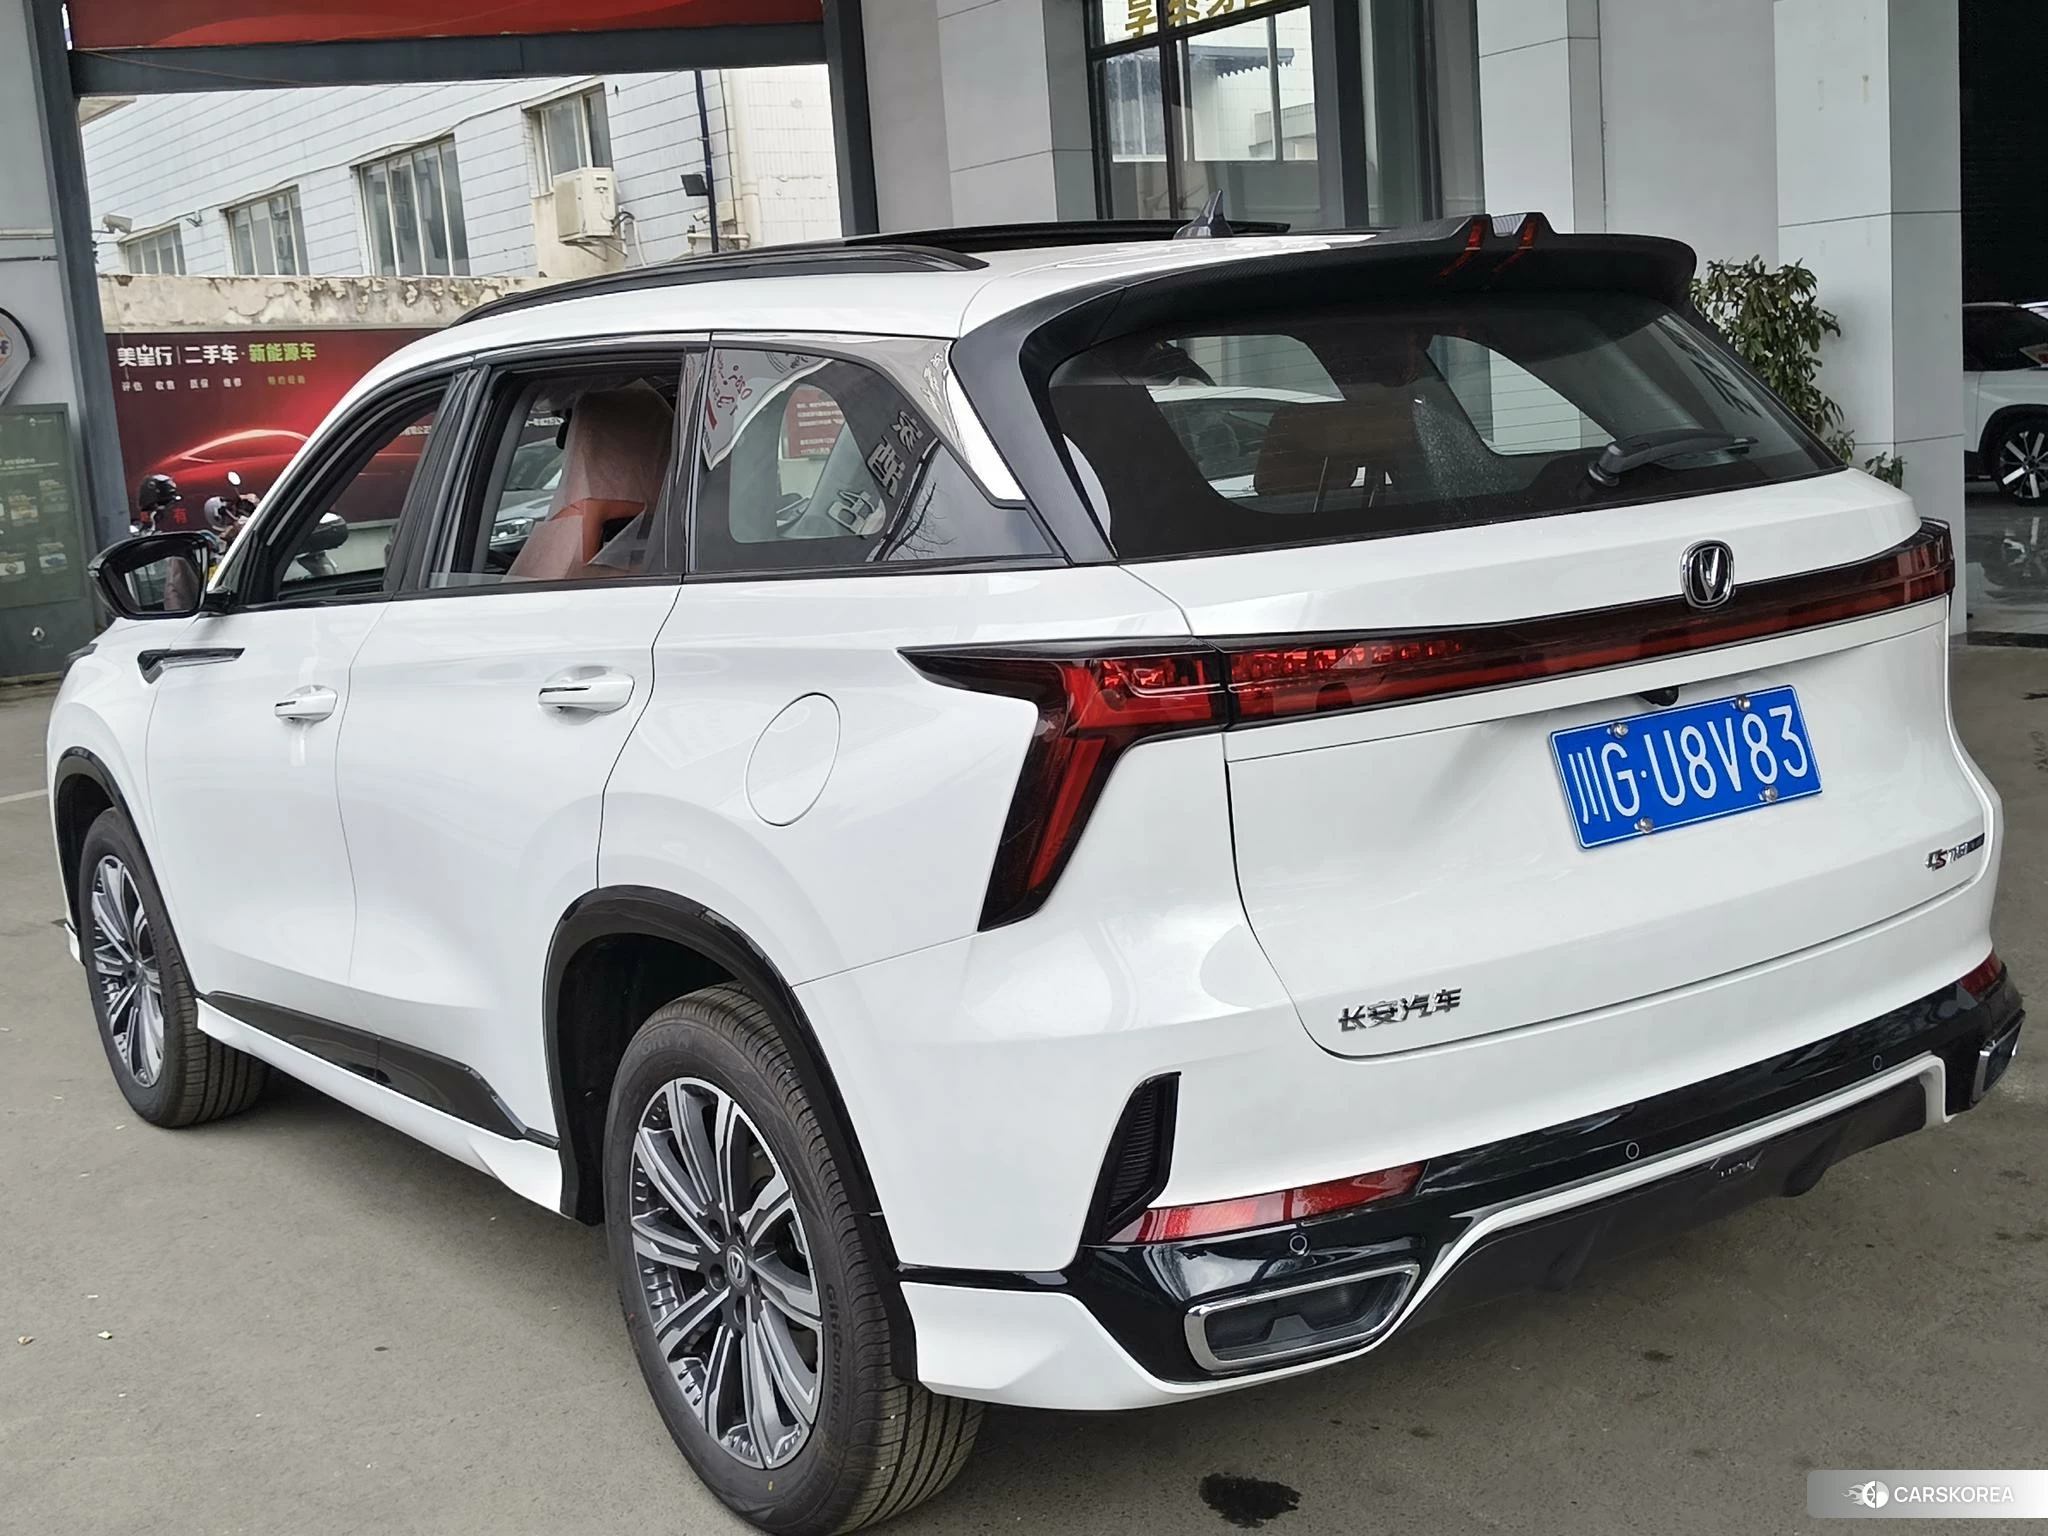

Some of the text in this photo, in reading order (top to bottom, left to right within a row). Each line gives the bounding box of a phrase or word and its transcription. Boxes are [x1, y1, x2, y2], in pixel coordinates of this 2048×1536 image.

[184, 344, 240, 365] 二手车
[248, 342, 317, 363] 新能源车
[1338, 988, 1462, 1032] 长安汽车
